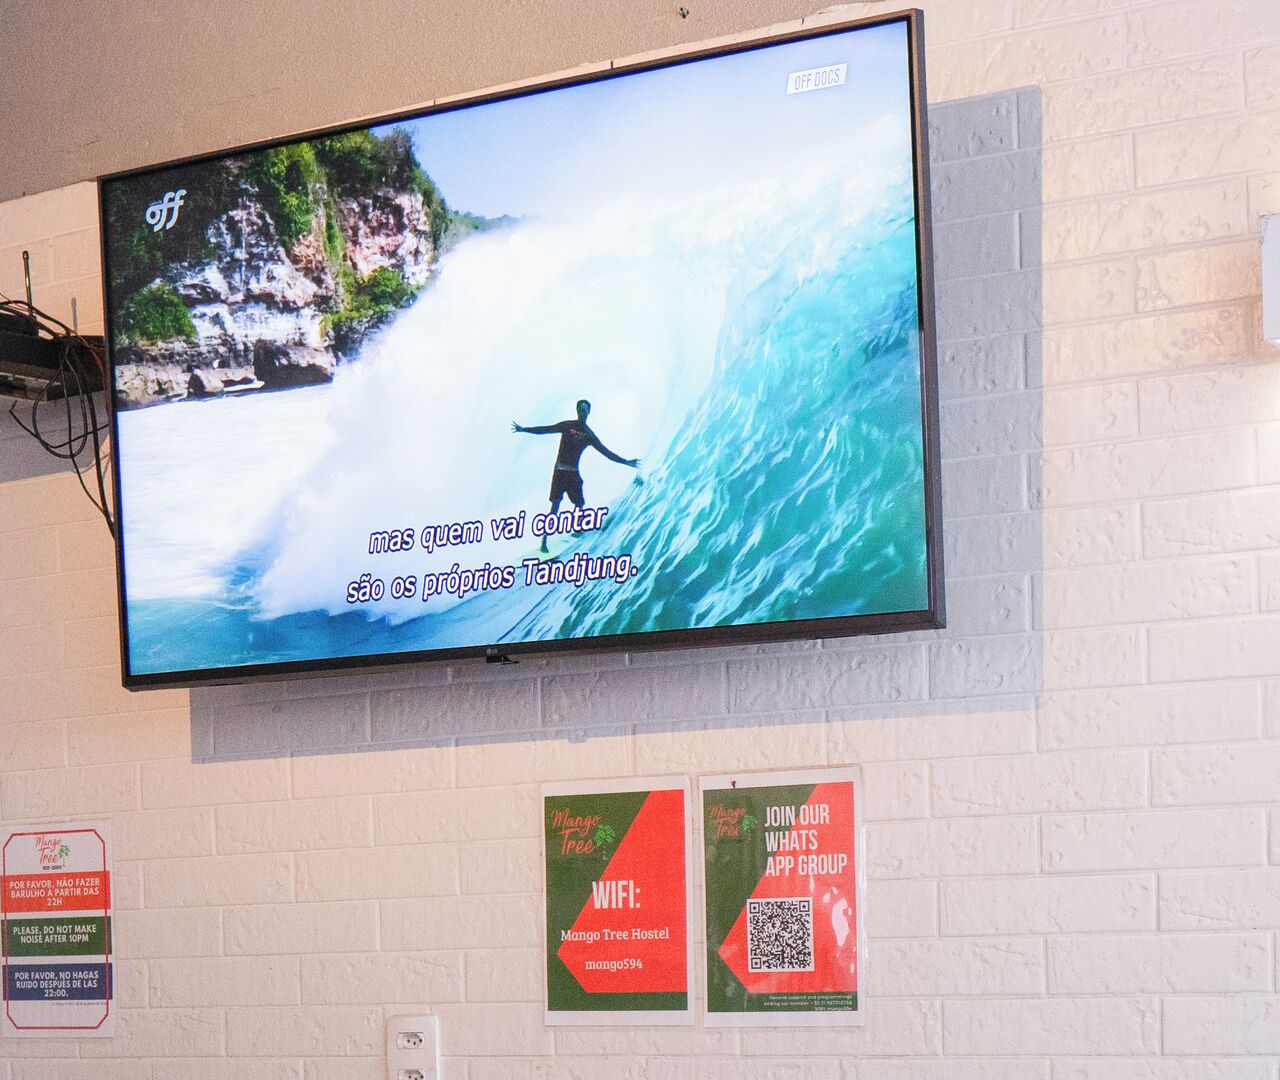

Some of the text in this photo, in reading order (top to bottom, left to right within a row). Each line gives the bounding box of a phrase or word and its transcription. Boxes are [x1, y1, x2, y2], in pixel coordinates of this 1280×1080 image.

[794, 68, 841, 91] OFF DOCS
[145, 189, 187, 233] off
[369, 504, 608, 554] mas quem vai contar
[347, 552, 638, 603] são os próprios Tandjung.
[552, 808, 601, 837] Mango
[764, 804, 830, 828] JOIN OUR
[556, 828, 595, 856] Tree
[764, 829, 818, 852] WHATS
[765, 853, 848, 877] APP GROUP
[10, 876, 100, 889] POR FAVOR, NÃO FAZER
[11, 889, 46, 898] BARULHO
[55, 888, 82, 896] PARTIR
[84, 887, 99, 895] DAS
[47, 898, 63, 906] 22H
[591, 880, 641, 909] WIFI:
[13, 924, 96, 935] PLEASE, DO NOT MAKE
[20, 934, 89, 943] NOISE AFTER 10PM
[560, 927, 669, 944] Mango Tree Hostel
[585, 958, 643, 972] mango594
[14, 970, 99, 981] POR FAVOR, NO HAGAS
[16, 980, 38, 988] RUIDO
[72, 980, 82, 988] DE
[83, 979, 98, 988] LAS
[44, 989, 69, 997] 22:00.
